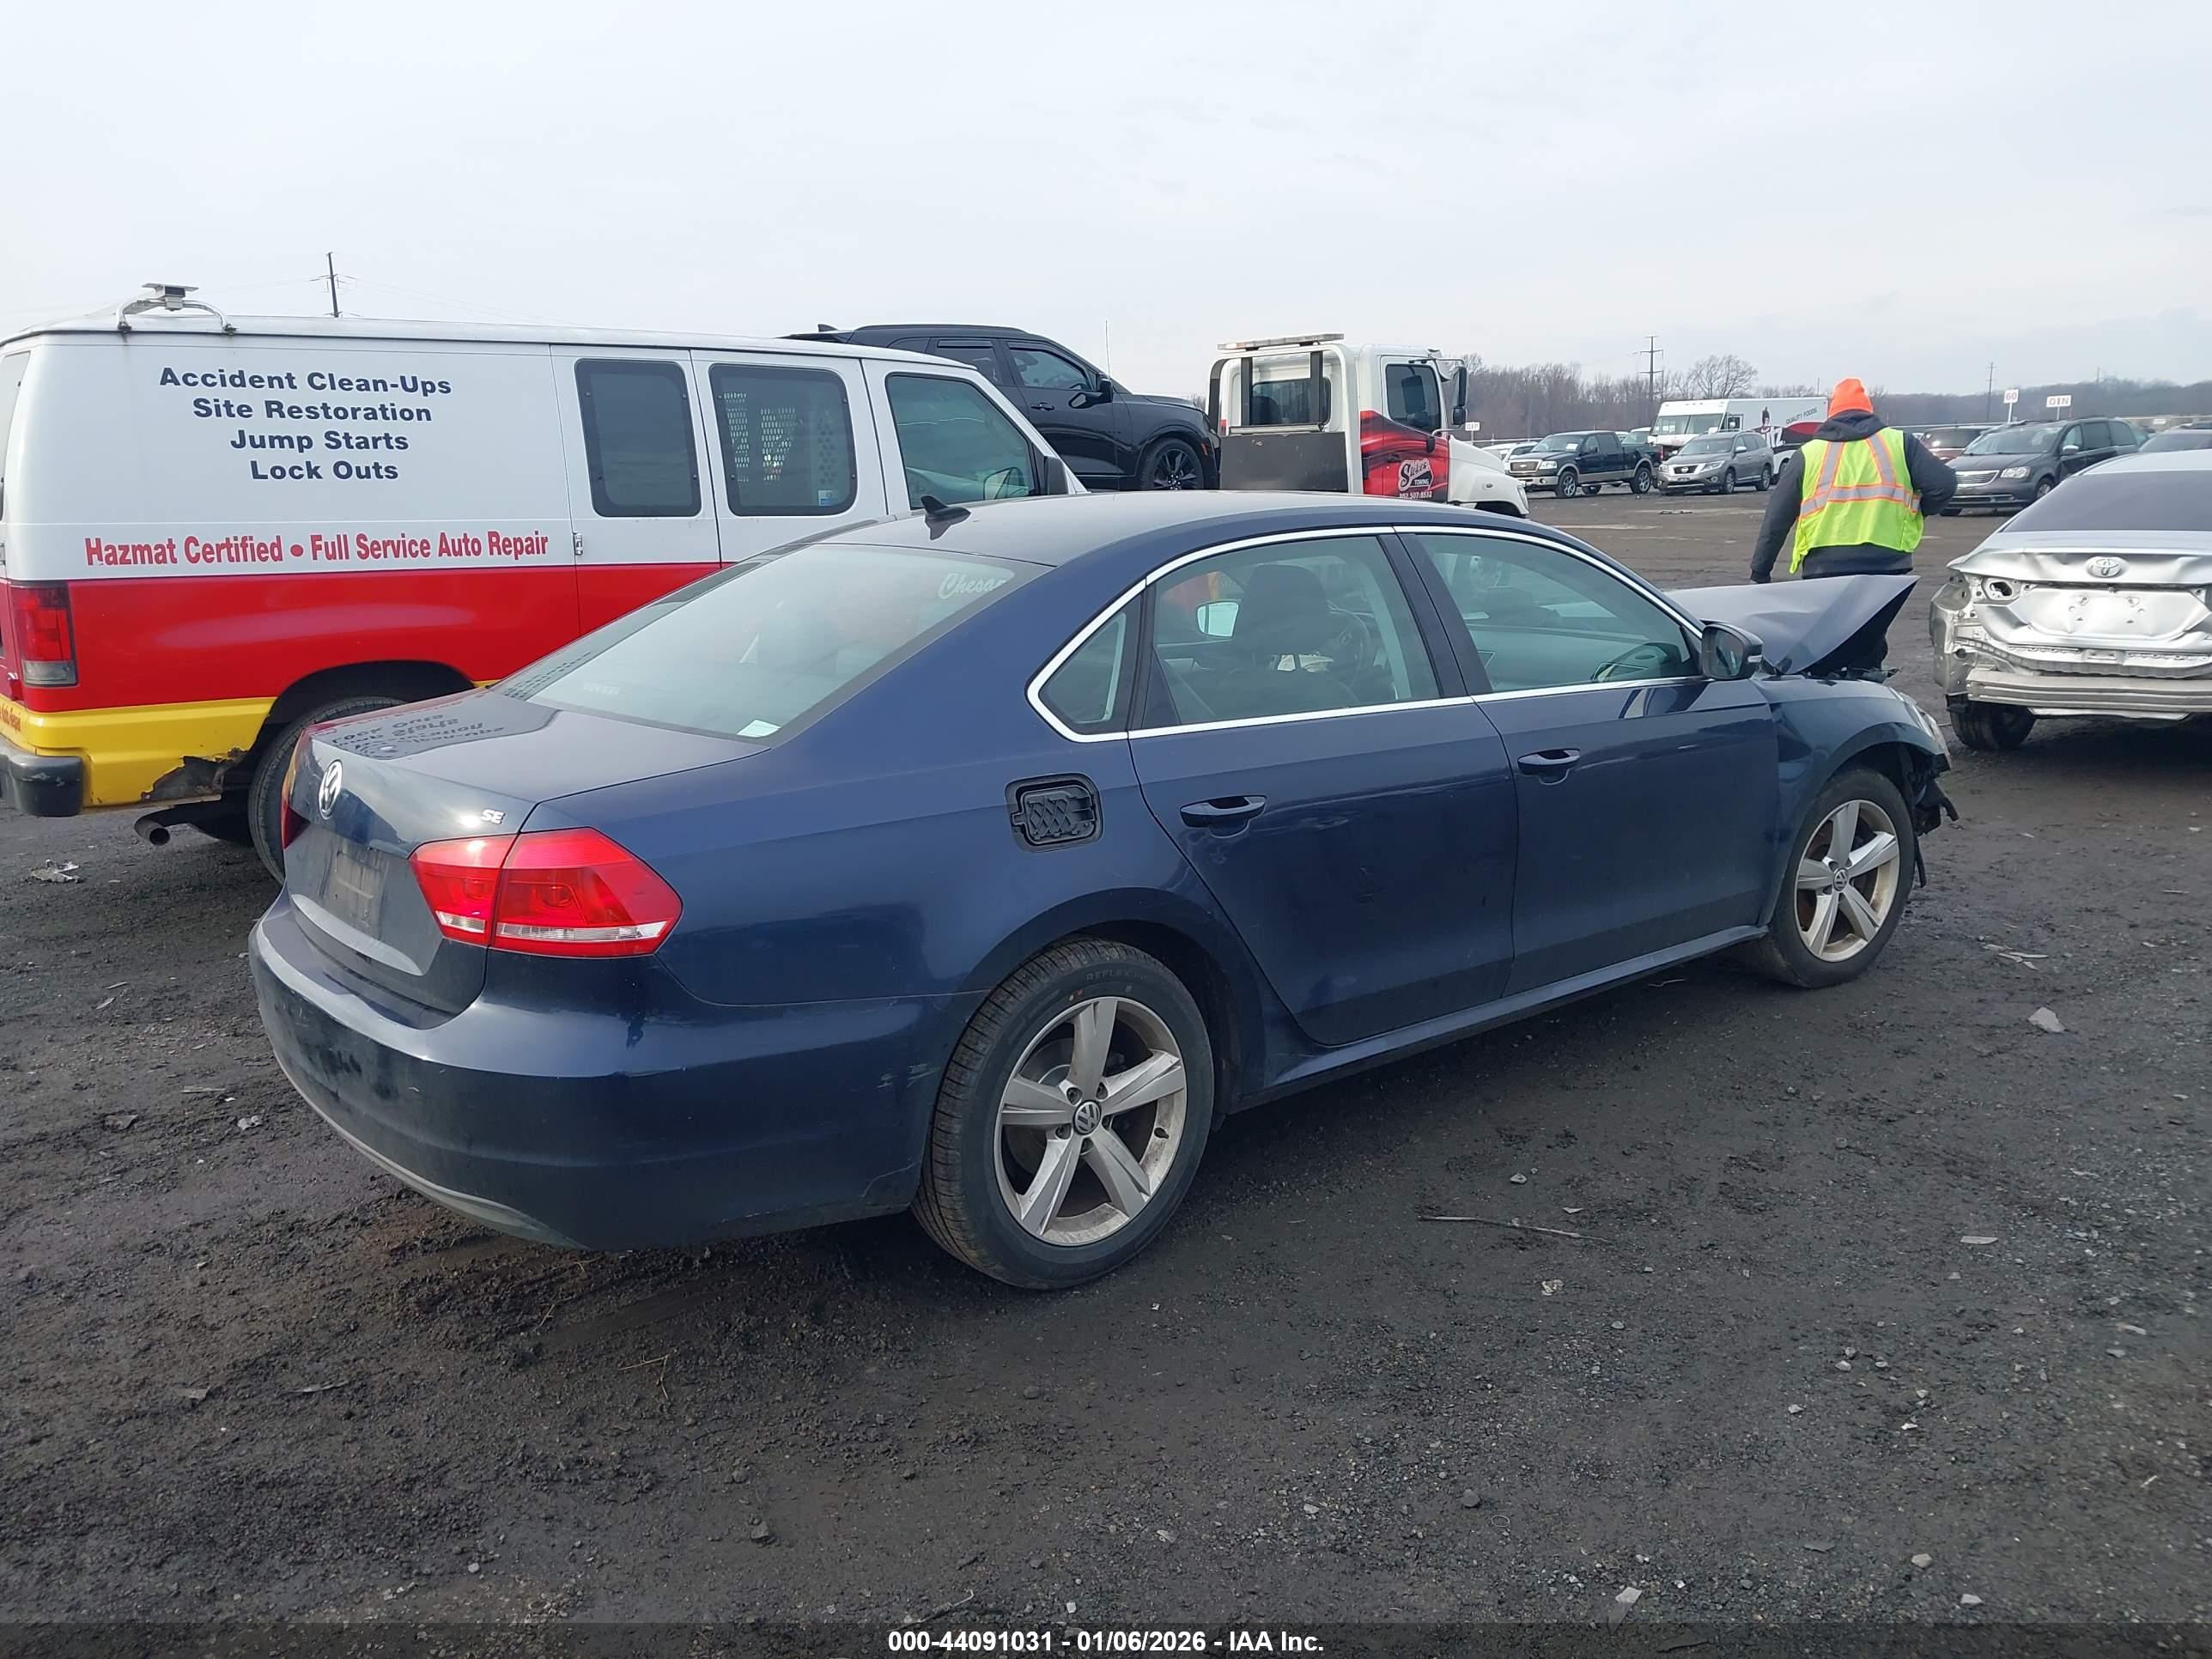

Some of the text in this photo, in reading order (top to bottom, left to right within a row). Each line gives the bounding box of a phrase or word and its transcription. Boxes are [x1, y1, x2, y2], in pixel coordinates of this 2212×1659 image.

[159, 367, 452, 398] Accident Clean-Ups
[193, 398, 432, 422] Site Restoration
[230, 429, 409, 453] Jump Starts
[250, 460, 399, 481] Lock Outs
[85, 530, 549, 566] Hazmat Certified Full Service Auto Repair
[481, 809, 505, 824] SE
